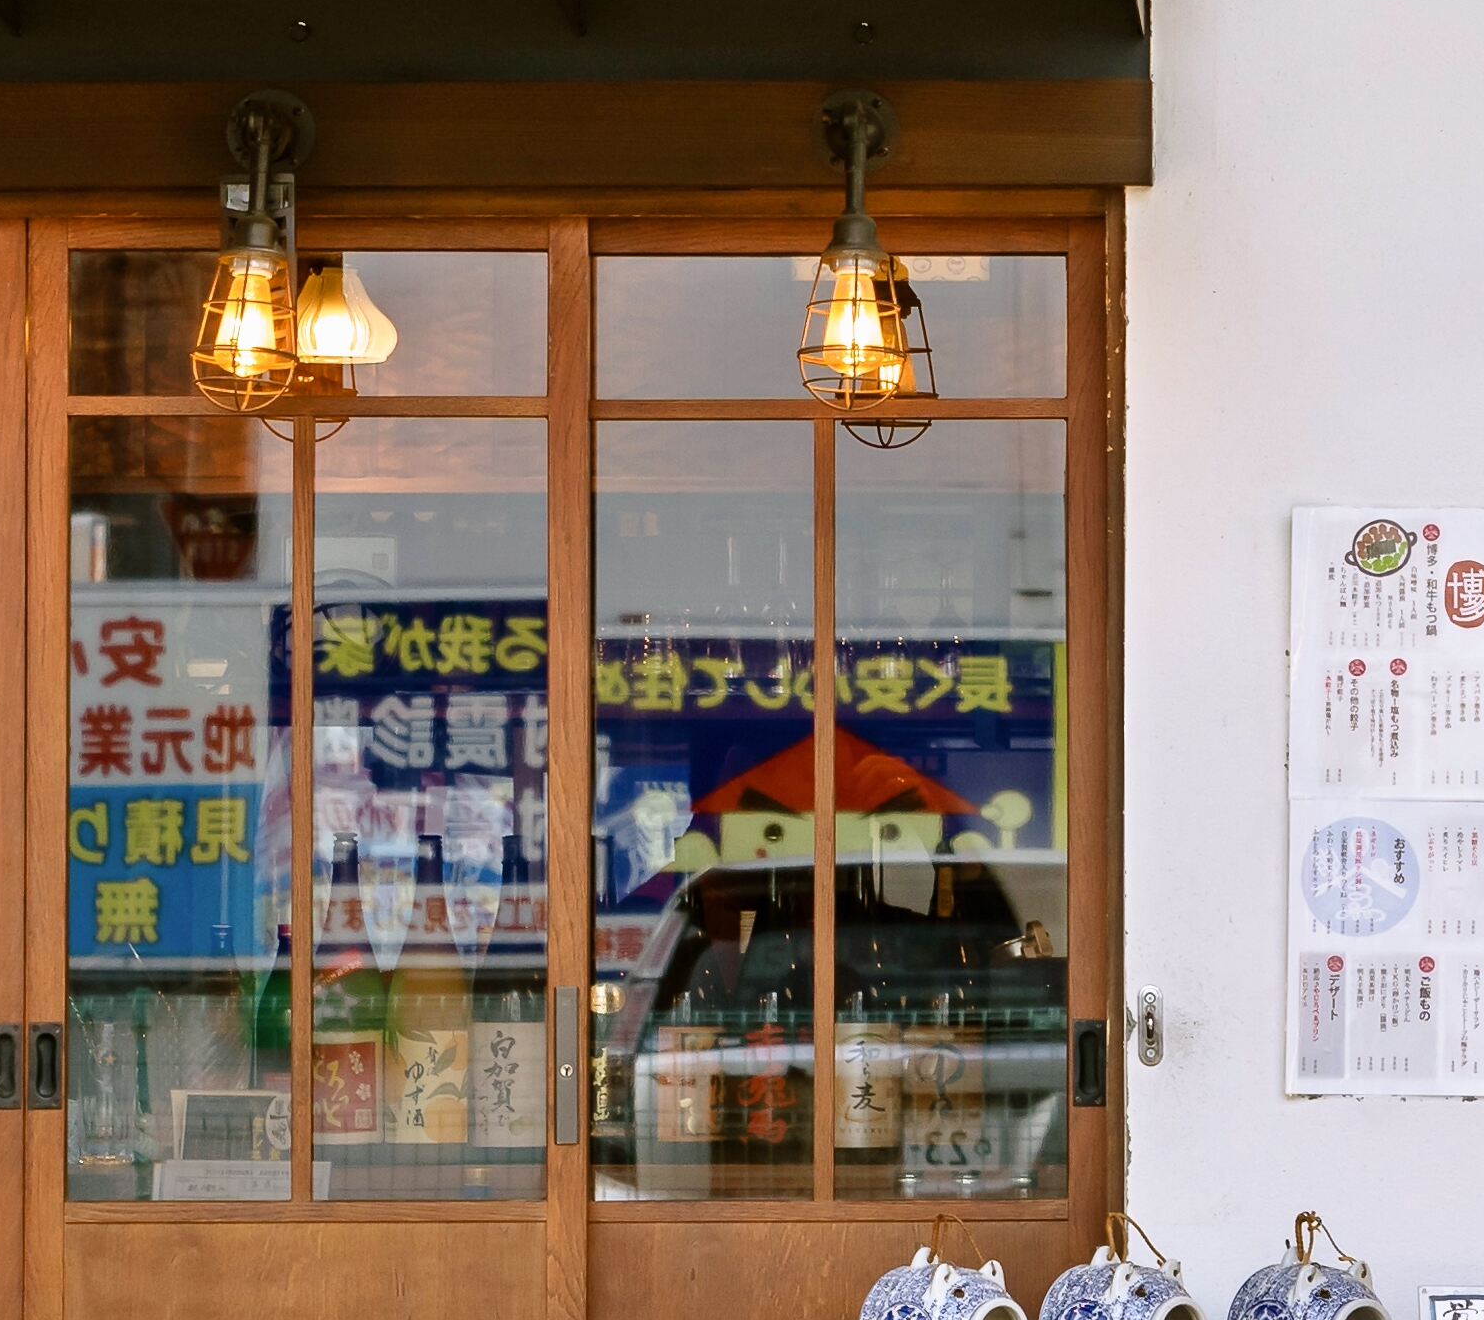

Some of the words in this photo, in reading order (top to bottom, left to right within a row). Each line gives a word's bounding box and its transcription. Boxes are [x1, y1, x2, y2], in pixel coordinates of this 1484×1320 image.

[1426, 543, 1438, 636] 博多・和牛もつ鍋
[1350, 679, 1359, 732] その他の餃子
[1393, 837, 1406, 885] おすすめ
[1328, 974, 1341, 1021] デザート
[1419, 976, 1432, 1022] ご飯もの
[404, 1061, 426, 1128] ゆず酒
[483, 1031, 520, 1113] 白加賀
